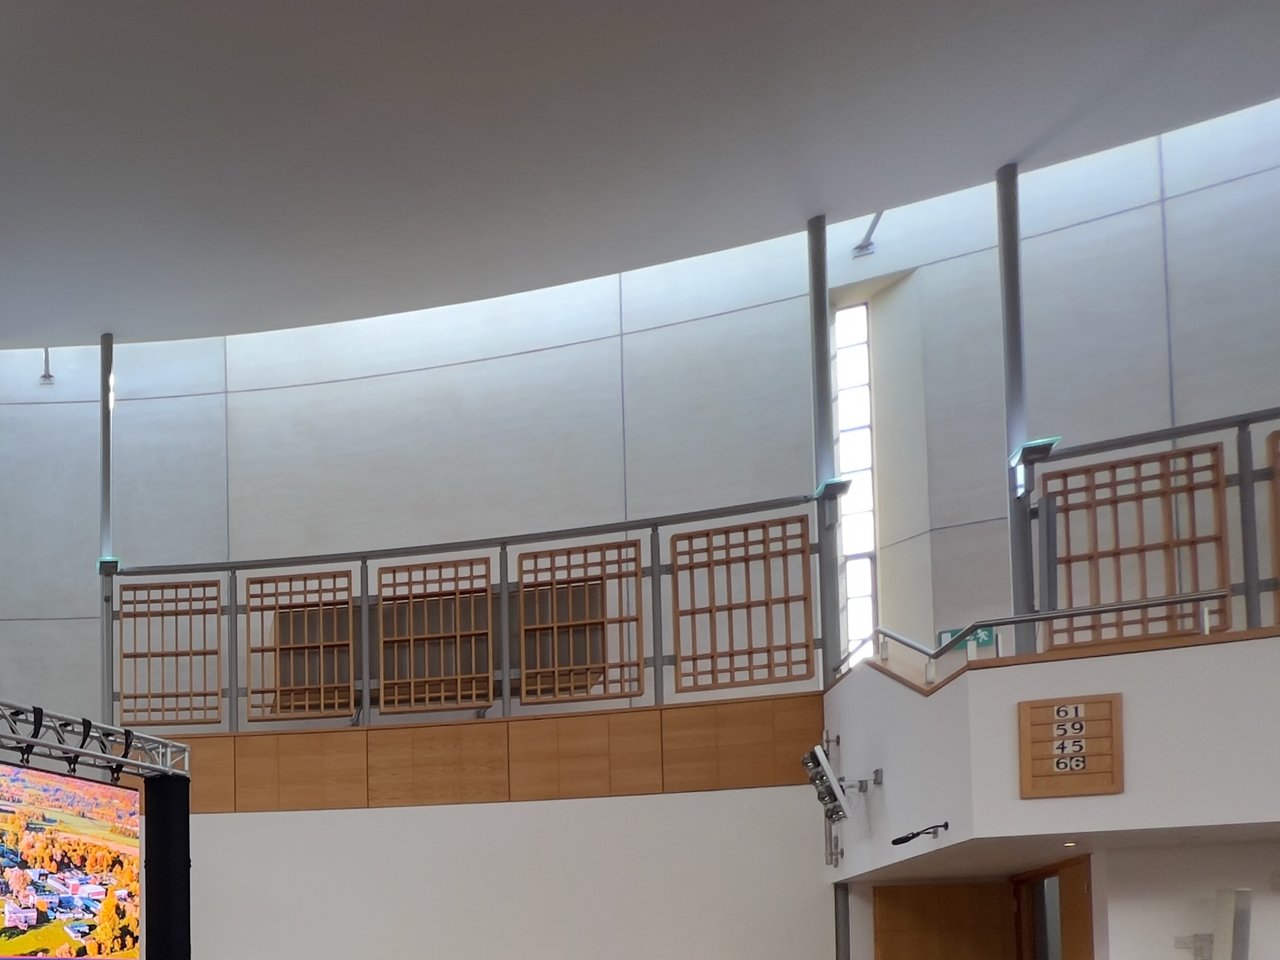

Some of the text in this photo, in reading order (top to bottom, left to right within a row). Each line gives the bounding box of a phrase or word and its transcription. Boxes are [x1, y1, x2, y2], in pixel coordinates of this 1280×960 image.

[1056, 705, 1080, 718] 61
[1056, 721, 1084, 737] 59
[1055, 739, 1084, 754] 45
[1056, 756, 1085, 770] 66
